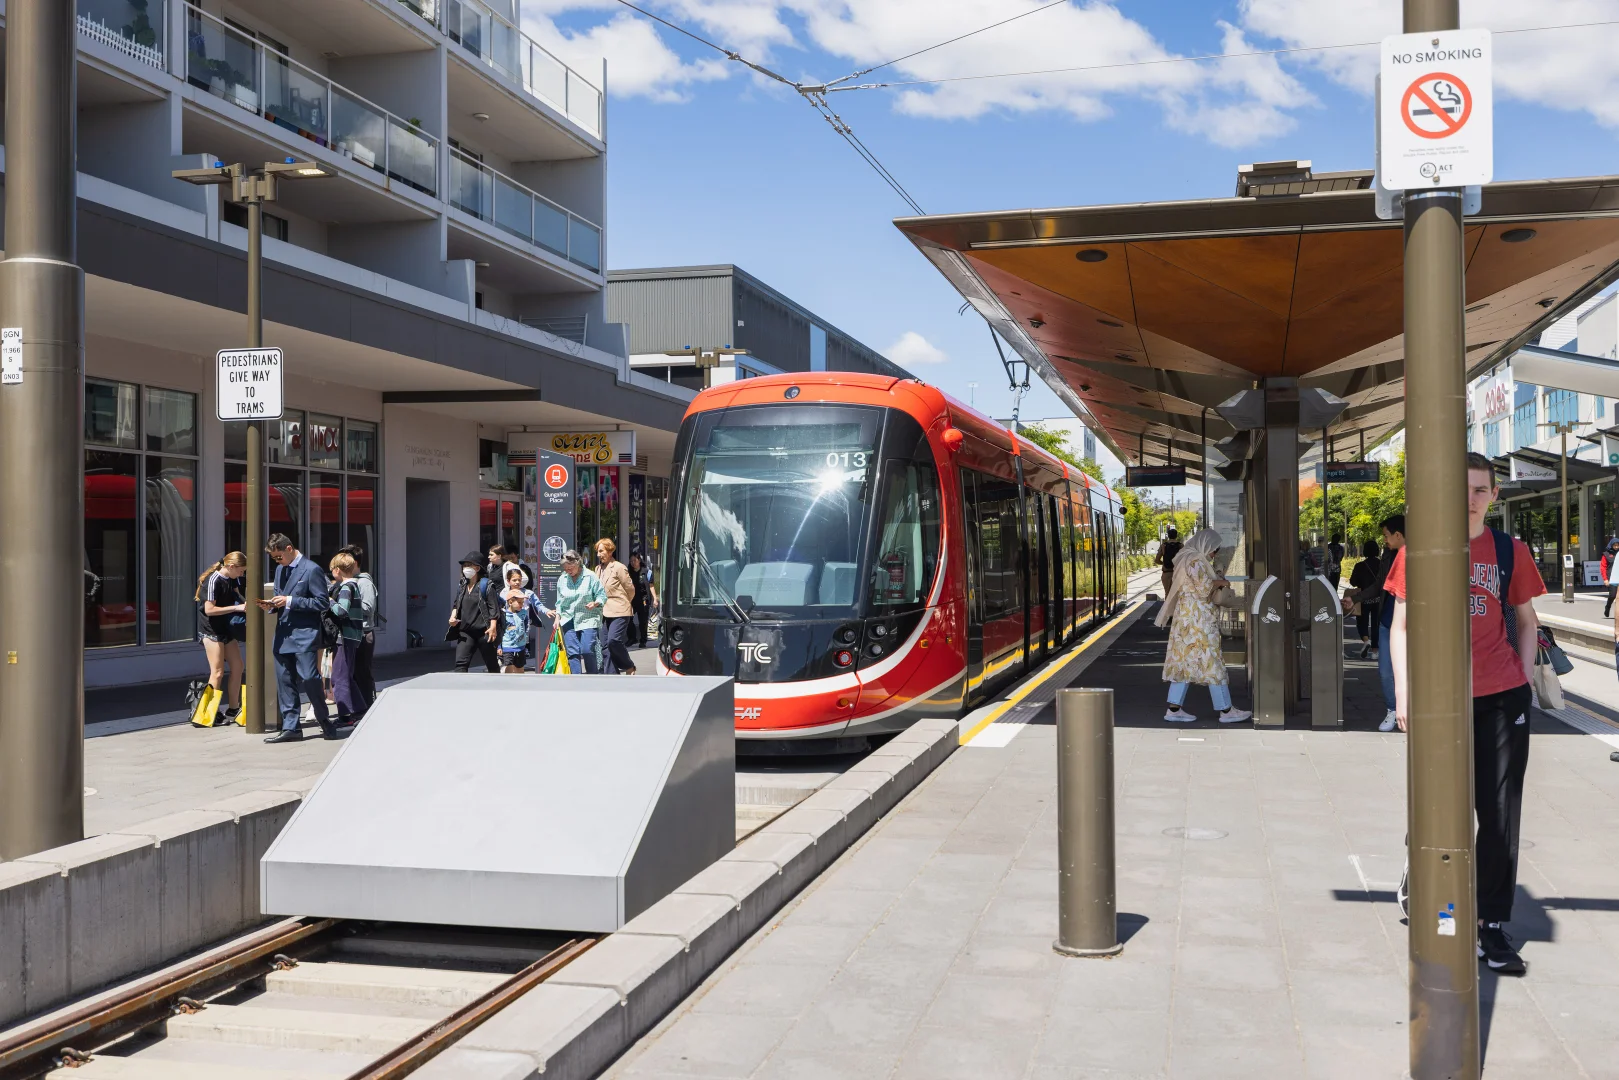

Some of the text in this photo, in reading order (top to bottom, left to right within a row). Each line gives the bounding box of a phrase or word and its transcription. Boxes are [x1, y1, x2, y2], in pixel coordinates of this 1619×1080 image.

[1392, 48, 1482, 64] NO SMOKING
[221, 354, 279, 368] PEDESTRIANS
[229, 370, 270, 383] GIVE WAY
[245, 386, 256, 398] TO
[236, 401, 265, 414] TRAMS
[826, 452, 866, 468] 013
[737, 642, 772, 664] TC
